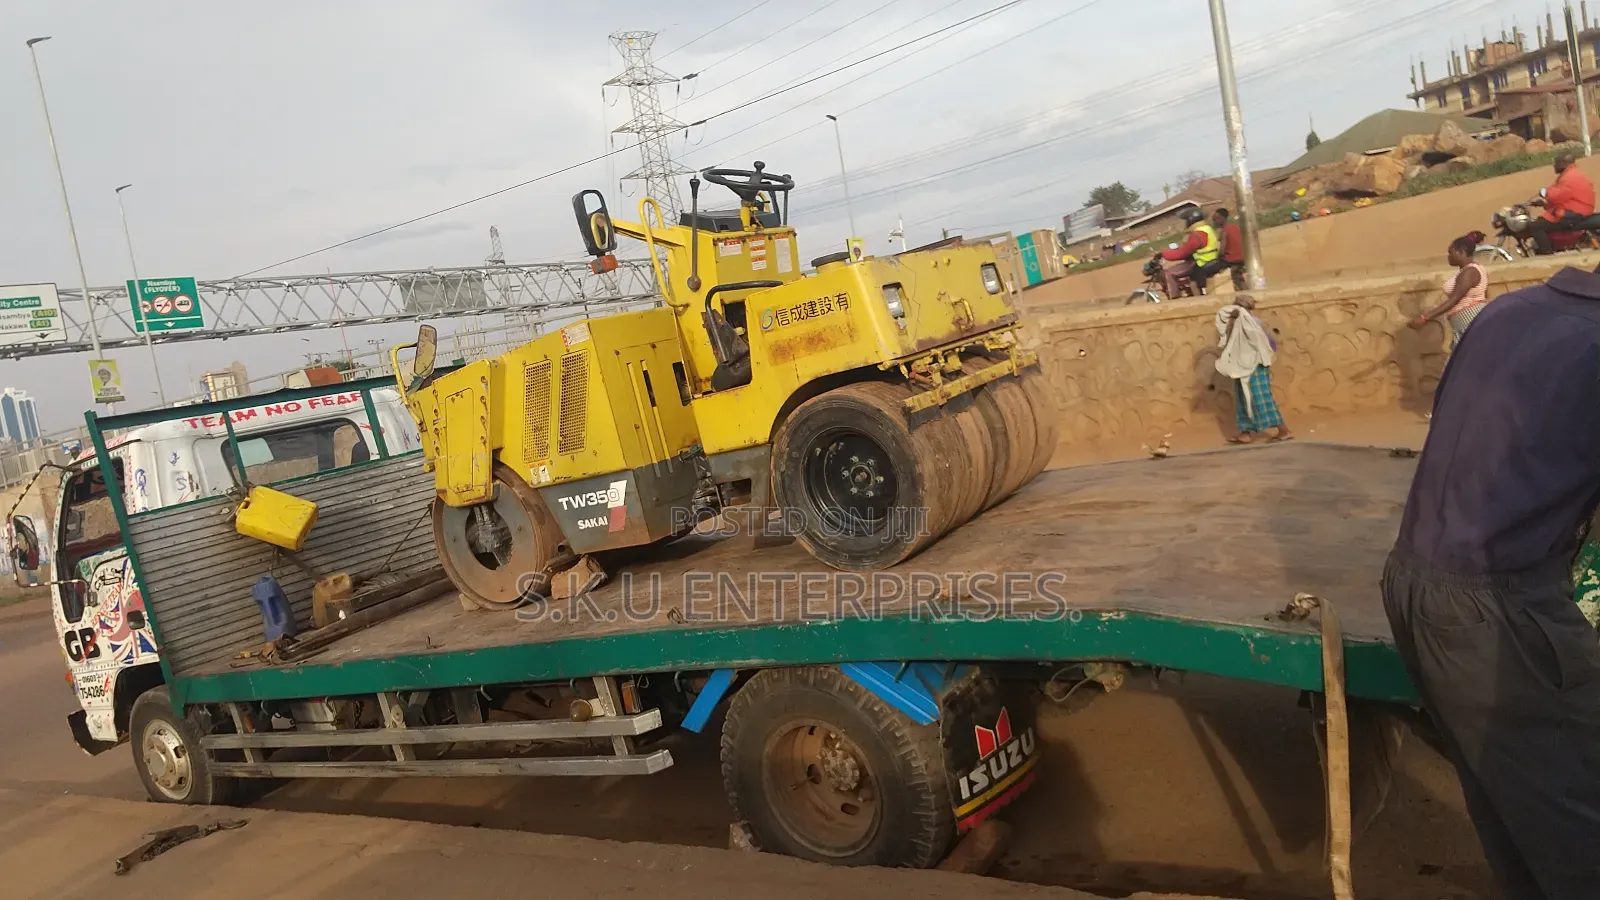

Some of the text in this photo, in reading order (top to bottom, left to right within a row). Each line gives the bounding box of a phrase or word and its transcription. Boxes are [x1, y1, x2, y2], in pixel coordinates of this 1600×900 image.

[13, 298, 40, 307] Centre
[182, 408, 258, 429] TEAM
[265, 401, 302, 417] NO
[558, 487, 620, 511] TW350
[577, 516, 608, 530] SAKAI
[64, 627, 101, 662] GB
[959, 726, 1035, 800] ISUZU
